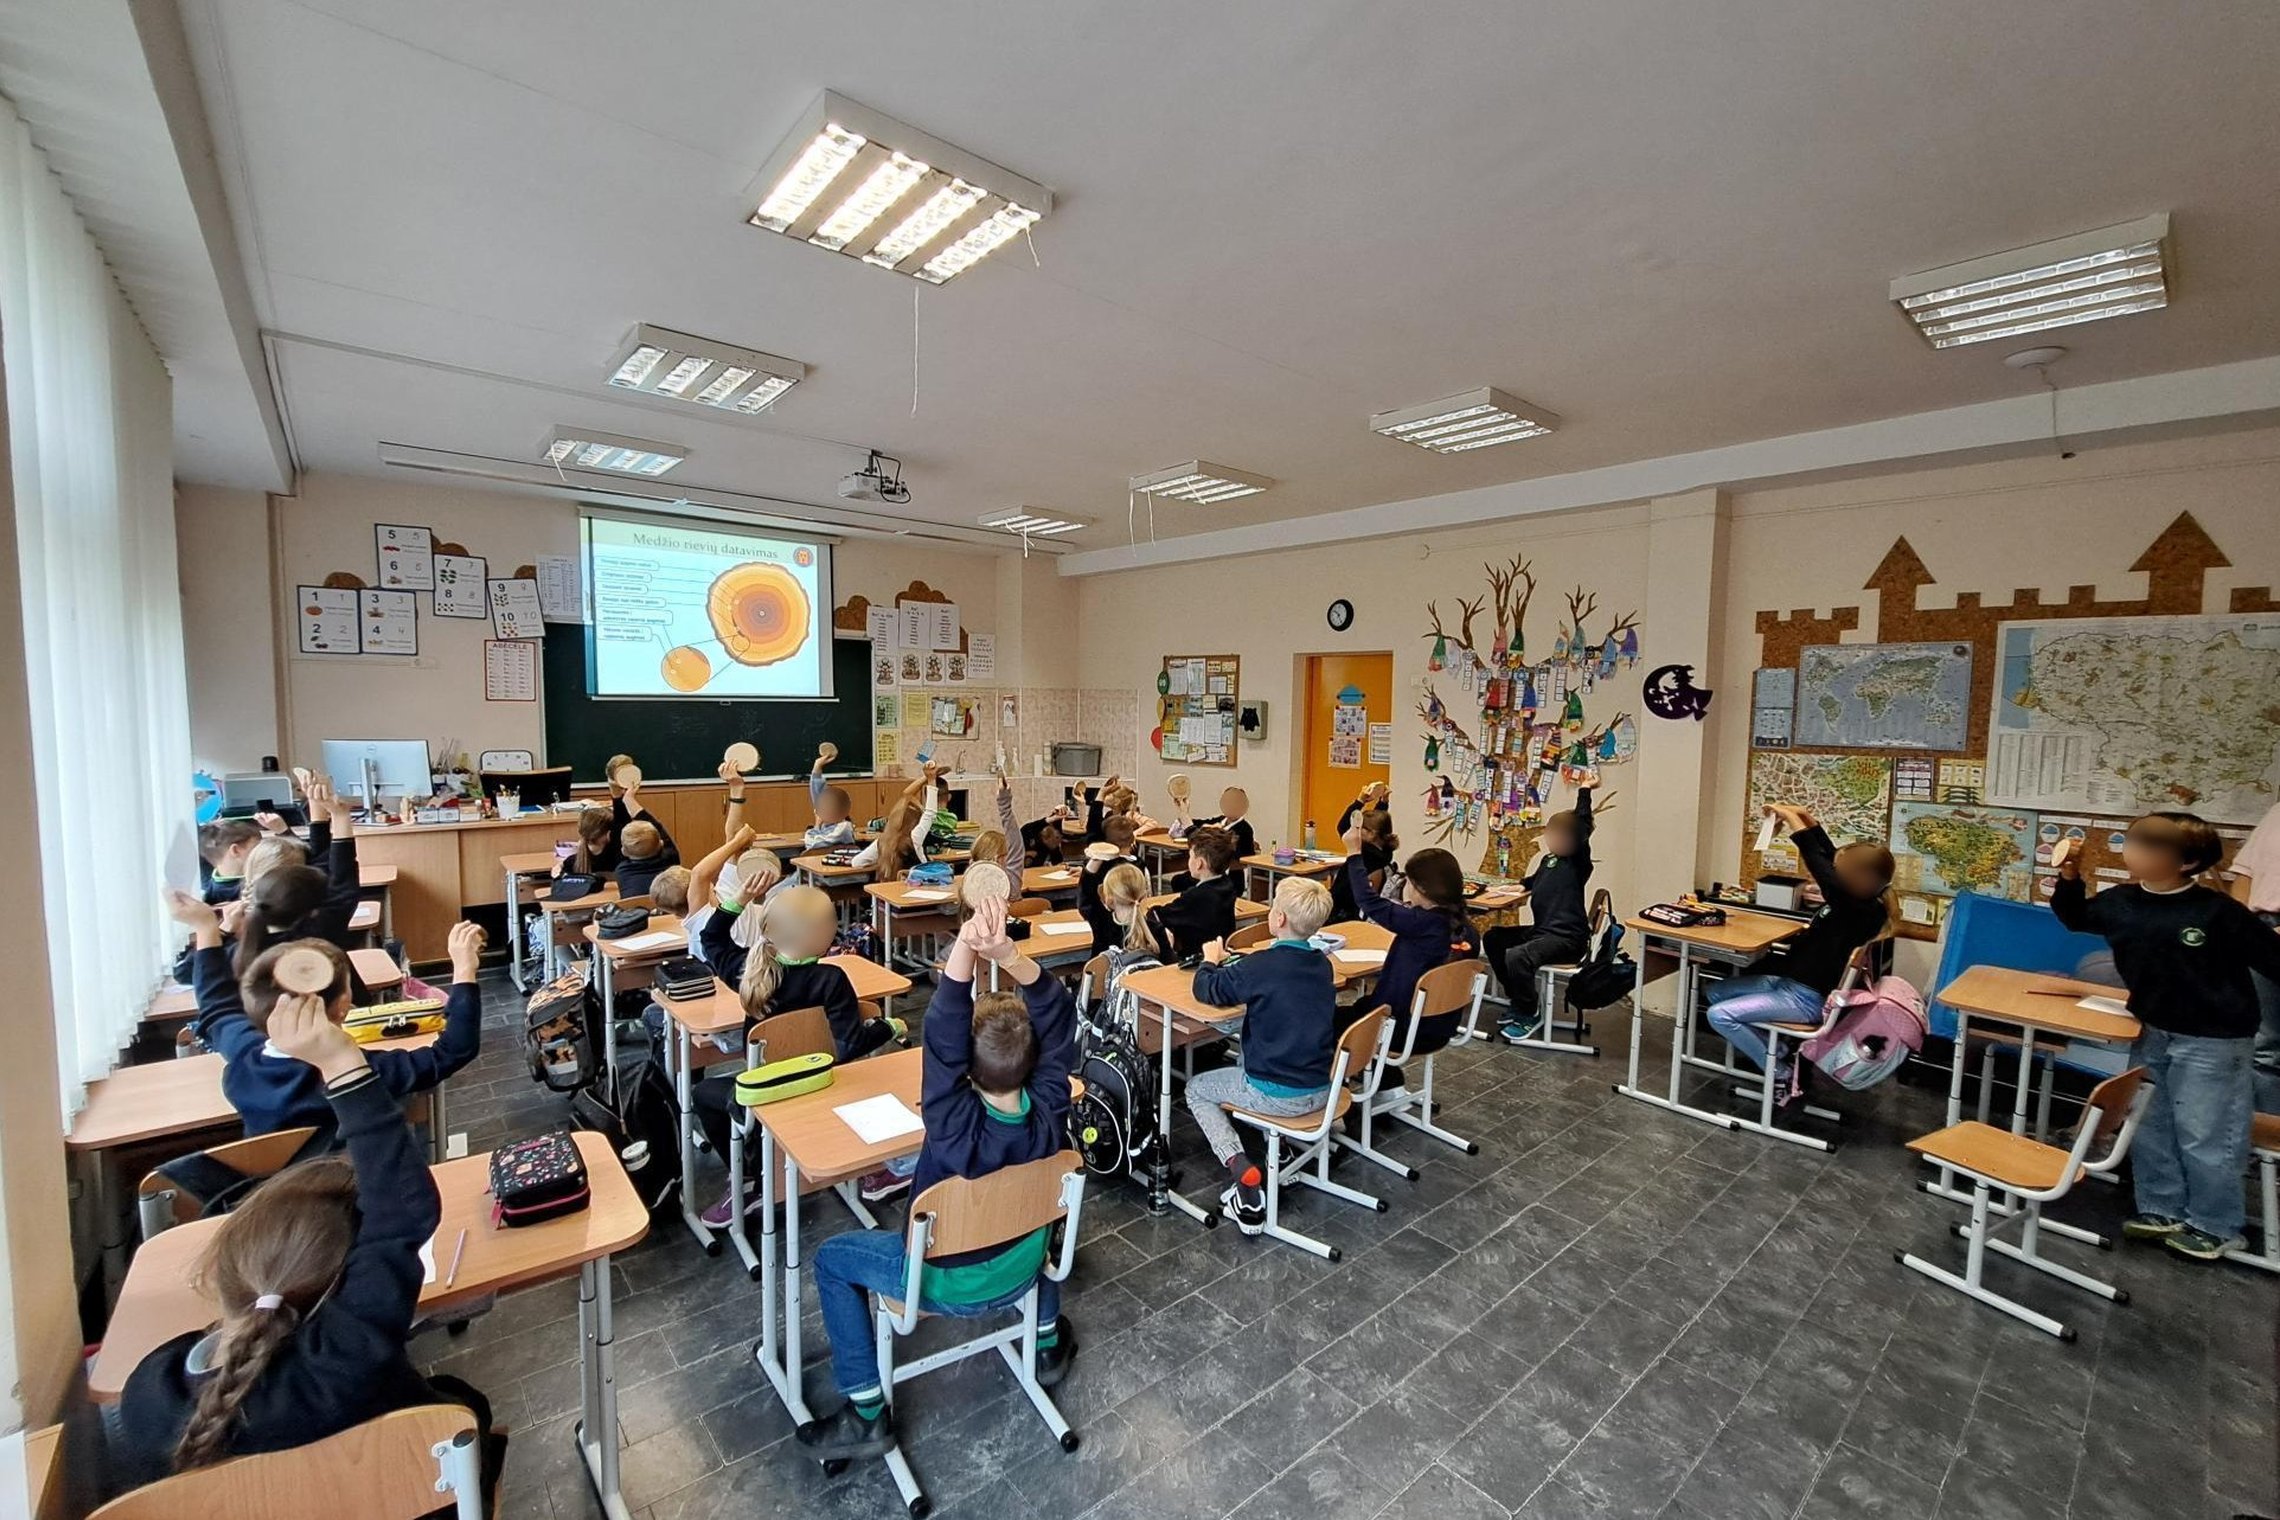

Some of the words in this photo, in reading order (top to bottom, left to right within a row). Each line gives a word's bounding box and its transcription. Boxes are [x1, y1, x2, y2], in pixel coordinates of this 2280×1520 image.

[388, 529, 396, 539] 5
[633, 532, 680, 548] Medžio
[684, 541, 718, 555] rievių
[721, 543, 778, 559] datavimas
[390, 561, 398, 570] 6
[444, 558, 451, 567] 7
[497, 583, 506, 592] 9
[311, 591, 318, 601] 1
[371, 593, 380, 603] 3
[444, 589, 452, 598] 8
[500, 612, 515, 621] 10
[312, 623, 321, 633] 2
[372, 625, 381, 634] 4
